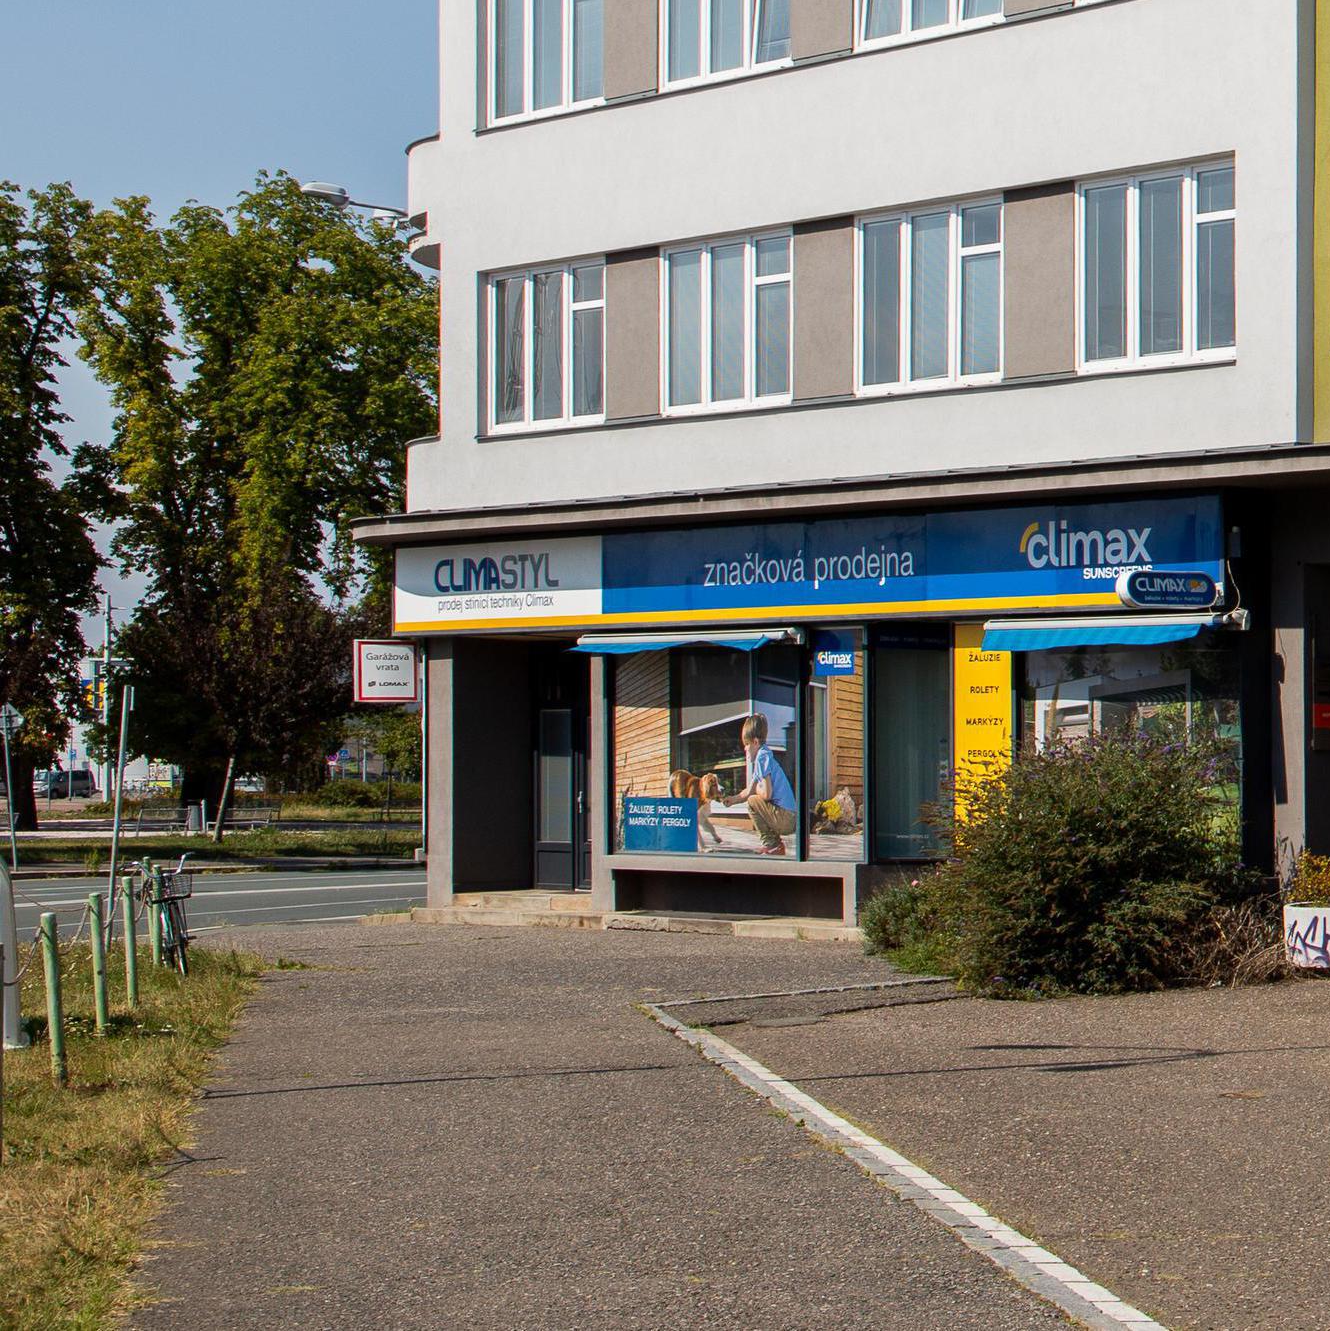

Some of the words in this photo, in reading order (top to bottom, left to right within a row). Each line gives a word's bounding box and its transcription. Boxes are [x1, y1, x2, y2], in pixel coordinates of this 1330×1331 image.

[1027, 520, 1152, 568] climax
[434, 553, 559, 592] CLIMASTYL
[704, 550, 805, 587] značková
[813, 545, 915, 590] prodejna
[1135, 577, 1186, 592] CLIMAX
[438, 597, 463, 614] prodej
[526, 593, 554, 607] Climax
[366, 652, 409, 661] Garážová
[820, 651, 852, 665] climax
[968, 651, 1001, 662] ŽALUZIE
[970, 685, 1000, 694] ROLETY
[966, 714, 1004, 726] MARKÝZY
[968, 749, 1003, 758] PERGOY
[628, 802, 655, 814] ŽALUZIE
[658, 805, 683, 815] ROLETY
[629, 815, 659, 826] MARKÝZY
[662, 817, 691, 827] PERGOLY
